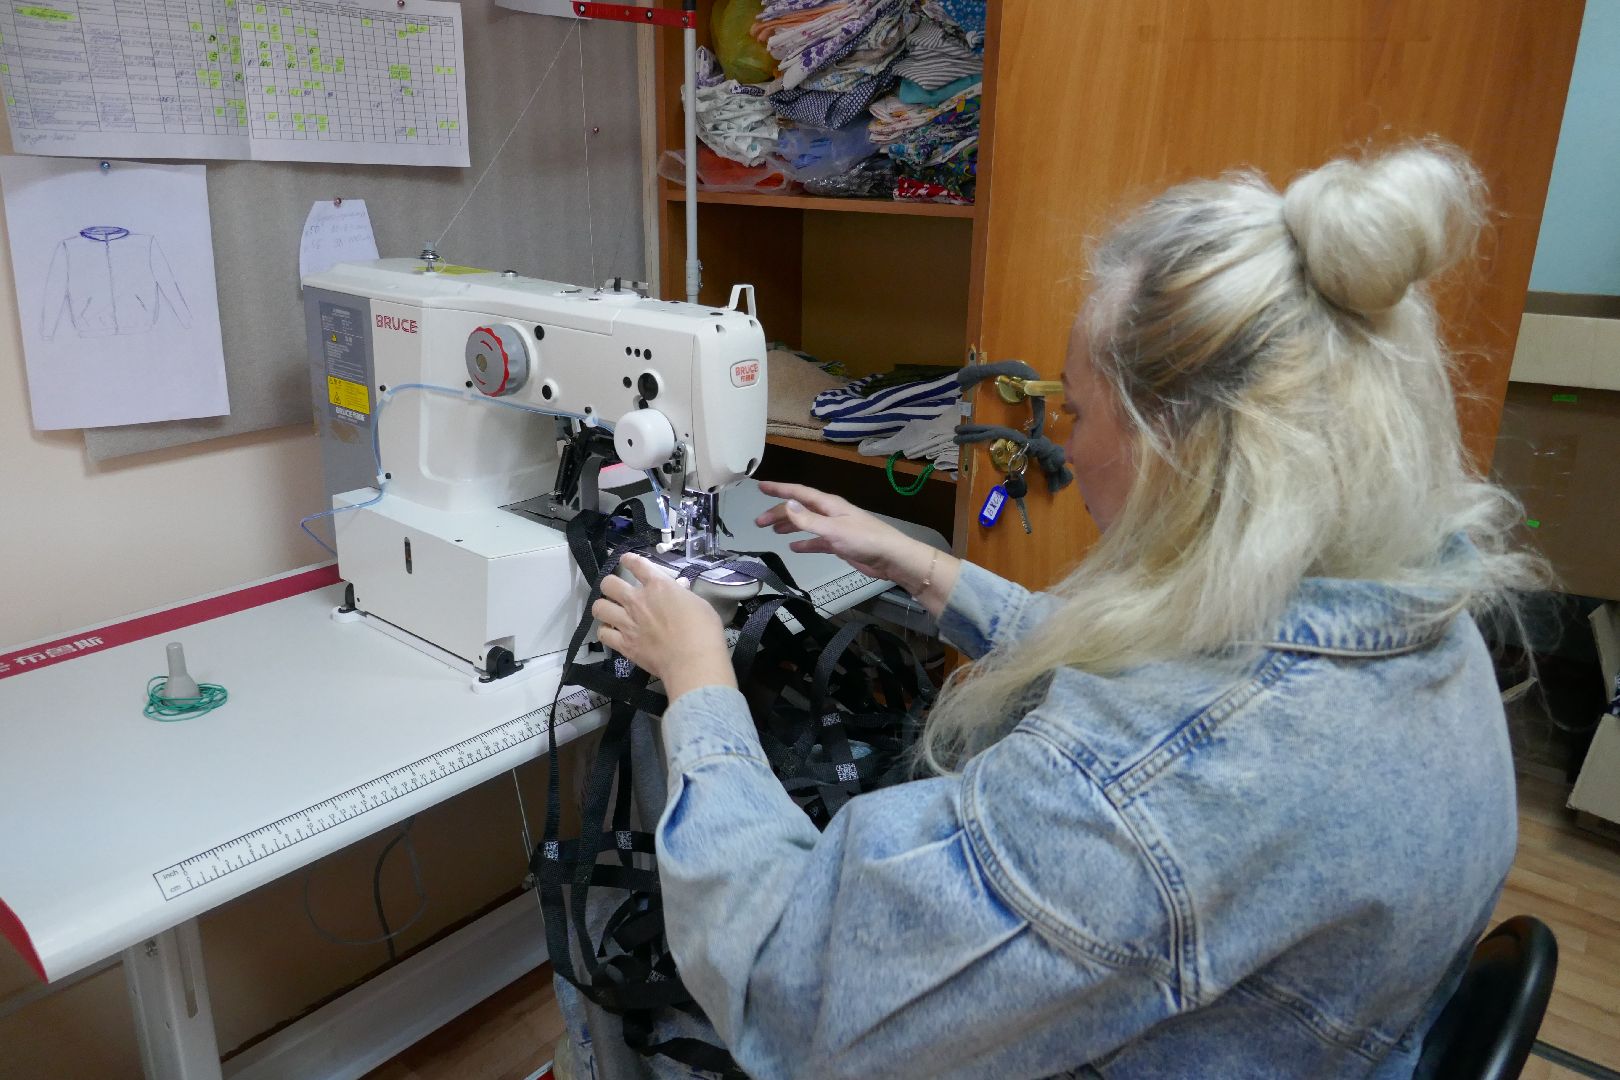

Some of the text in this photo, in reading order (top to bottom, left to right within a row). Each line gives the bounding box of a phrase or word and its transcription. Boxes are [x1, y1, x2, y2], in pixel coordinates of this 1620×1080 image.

[375, 314, 418, 334] BRUCE
[735, 363, 758, 376] BRUCE
[162, 870, 180, 880] inch
